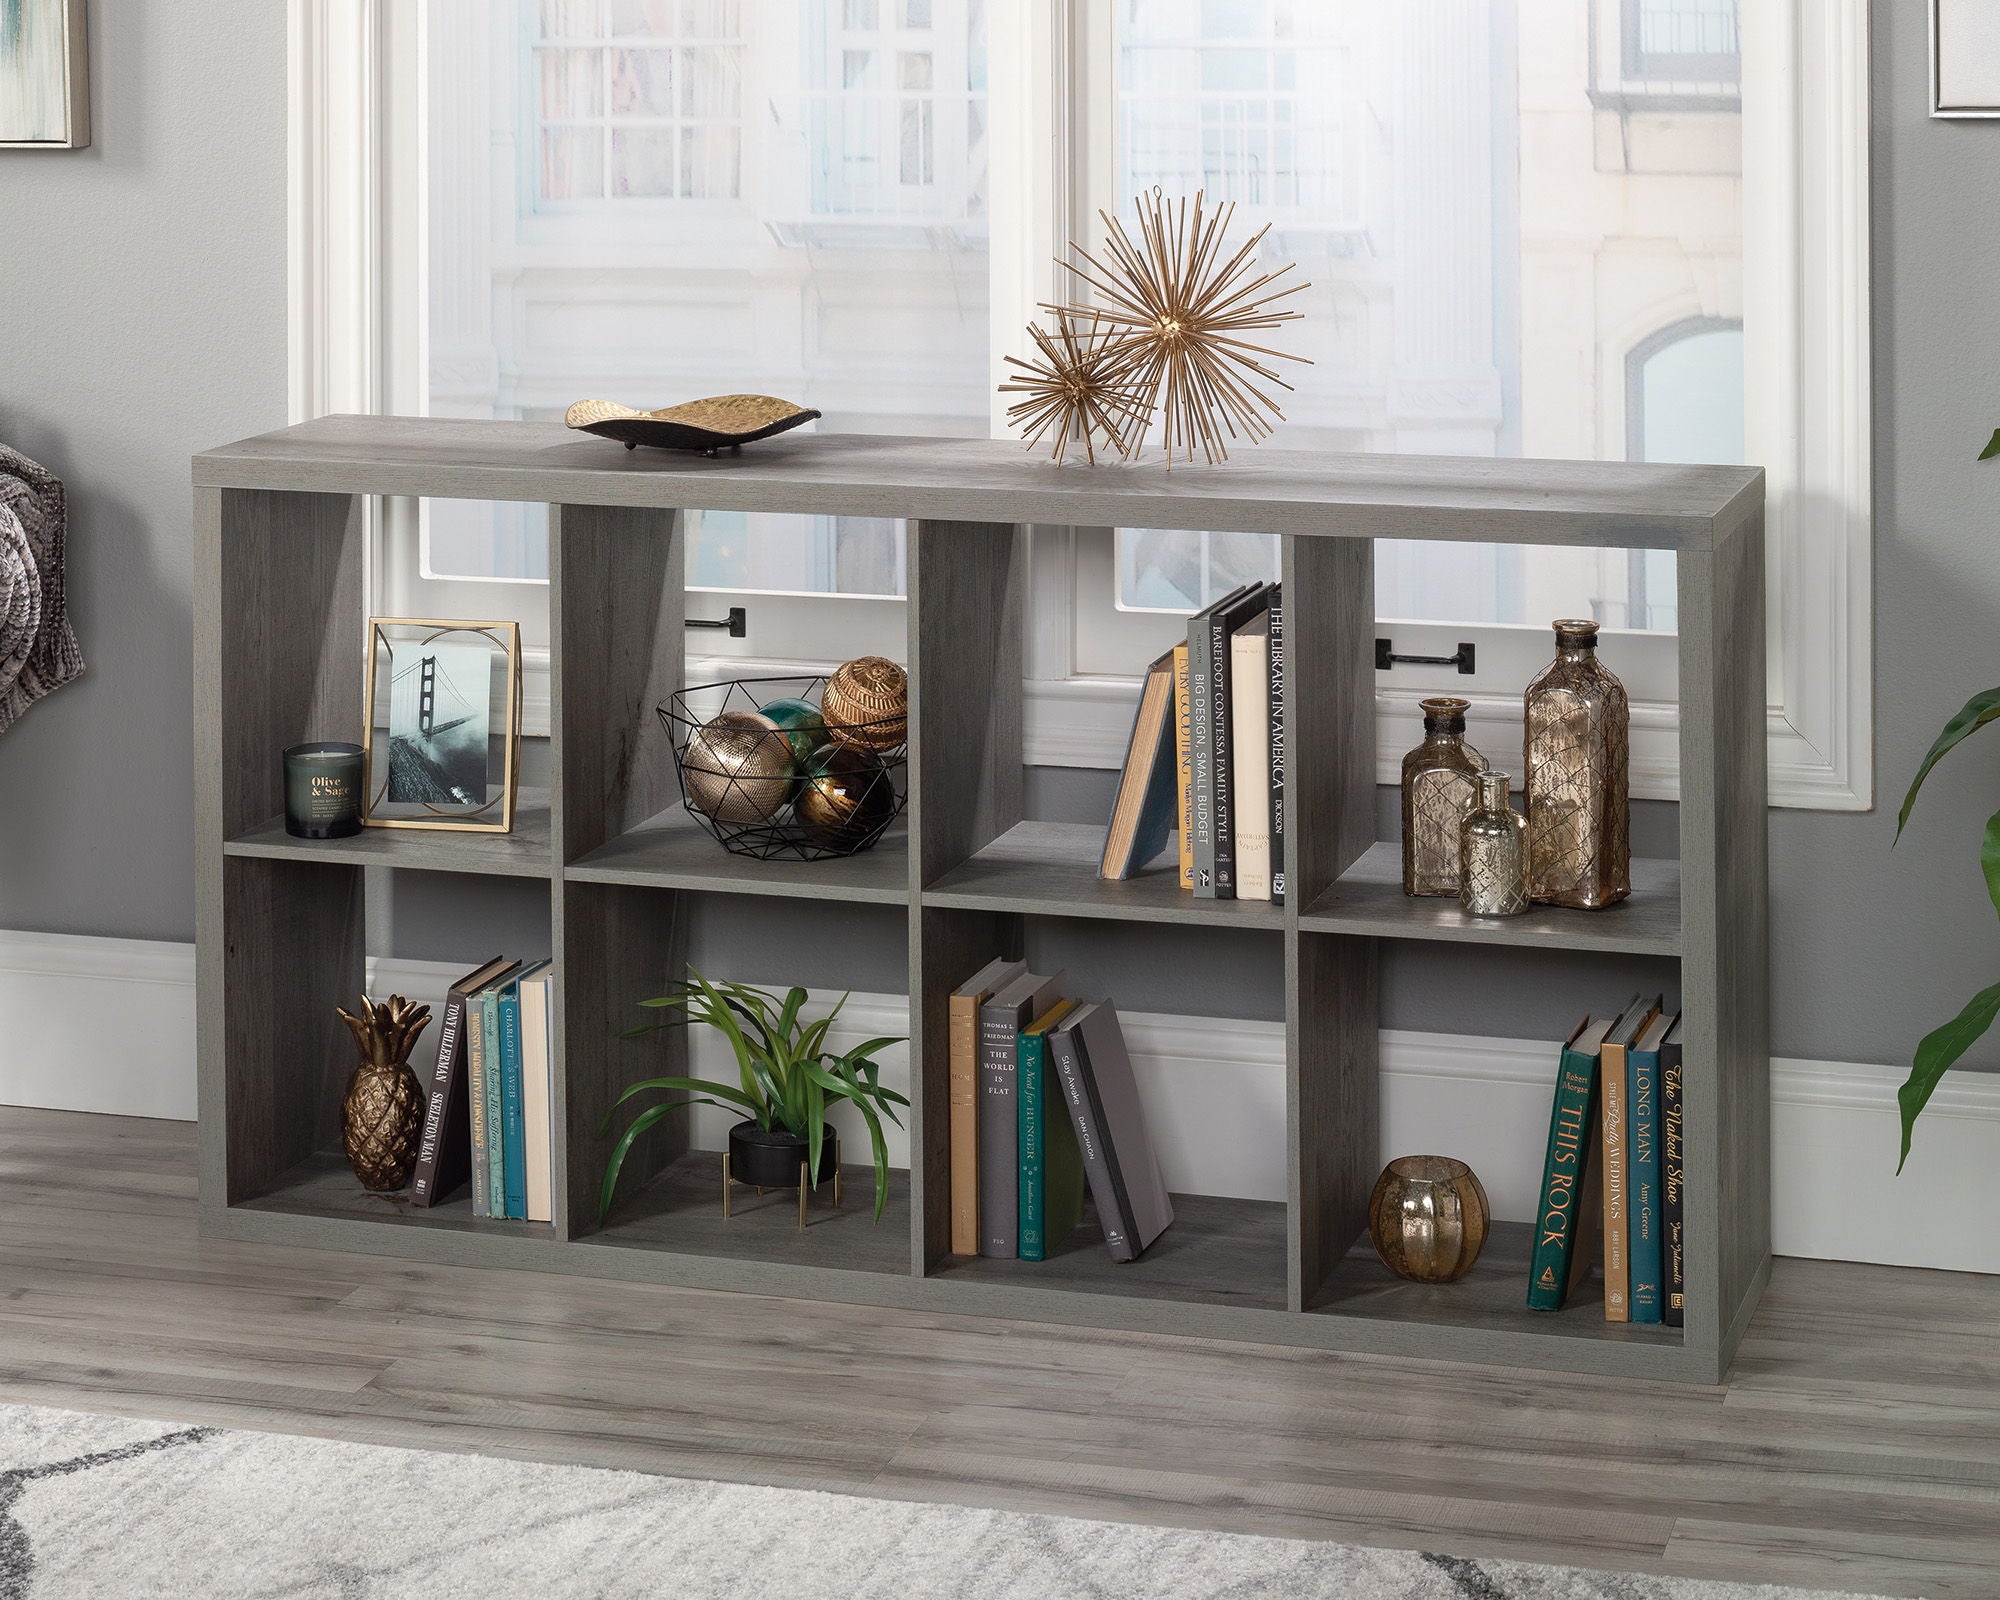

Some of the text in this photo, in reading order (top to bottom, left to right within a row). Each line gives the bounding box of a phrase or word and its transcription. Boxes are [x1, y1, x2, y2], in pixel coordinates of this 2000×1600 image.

[1179, 658, 1190, 691] EVERY
[1180, 693, 1190, 736] GOOD
[1271, 607, 1284, 789] THE LIBRARY IN AMERICA
[1213, 626, 1228, 842] BAREFOOT CONTESSA FAMILY STYLE
[1194, 674, 1208, 845] BIG DESIGN, SMALL BUDGET
[311, 777, 341, 787] Olive
[311, 786, 350, 797] & Sage
[1275, 799, 1284, 834] DICKSON
[435, 1003, 460, 1083] TONY HILLERMAN
[990, 1051, 1008, 1059] THE
[472, 1051, 482, 1091] MORALITY
[508, 1075, 516, 1098] WEB
[984, 1062, 1015, 1071] WORLD
[1061, 1055, 1080, 1105] Stay Awake
[1562, 1081, 1589, 1094] Morgan
[1566, 1071, 1588, 1084] Robert
[488, 1066, 499, 1151] Sharing His Suffering
[988, 1087, 1010, 1095] FLAT
[1024, 1054, 1036, 1159] No Need for HUNGER
[1609, 1082, 1617, 1099] STYLE
[425, 1091, 444, 1141] SKELETON
[1554, 1104, 1583, 1164] THIS
[1604, 1103, 1621, 1146] Pretty
[1636, 1067, 1650, 1163] LONG MAN
[1664, 1064, 1683, 1207] The Naked Shoe
[420, 1140, 434, 1163] MAN
[1078, 1116, 1095, 1160] DAN CHAON
[1610, 1147, 1621, 1219] WEDDINGS
[1541, 1172, 1574, 1249] ROCK
[1638, 1182, 1652, 1240] Amy Greene
[1669, 1221, 1681, 1243] Jane
[1612, 1246, 1620, 1270] LARSON
